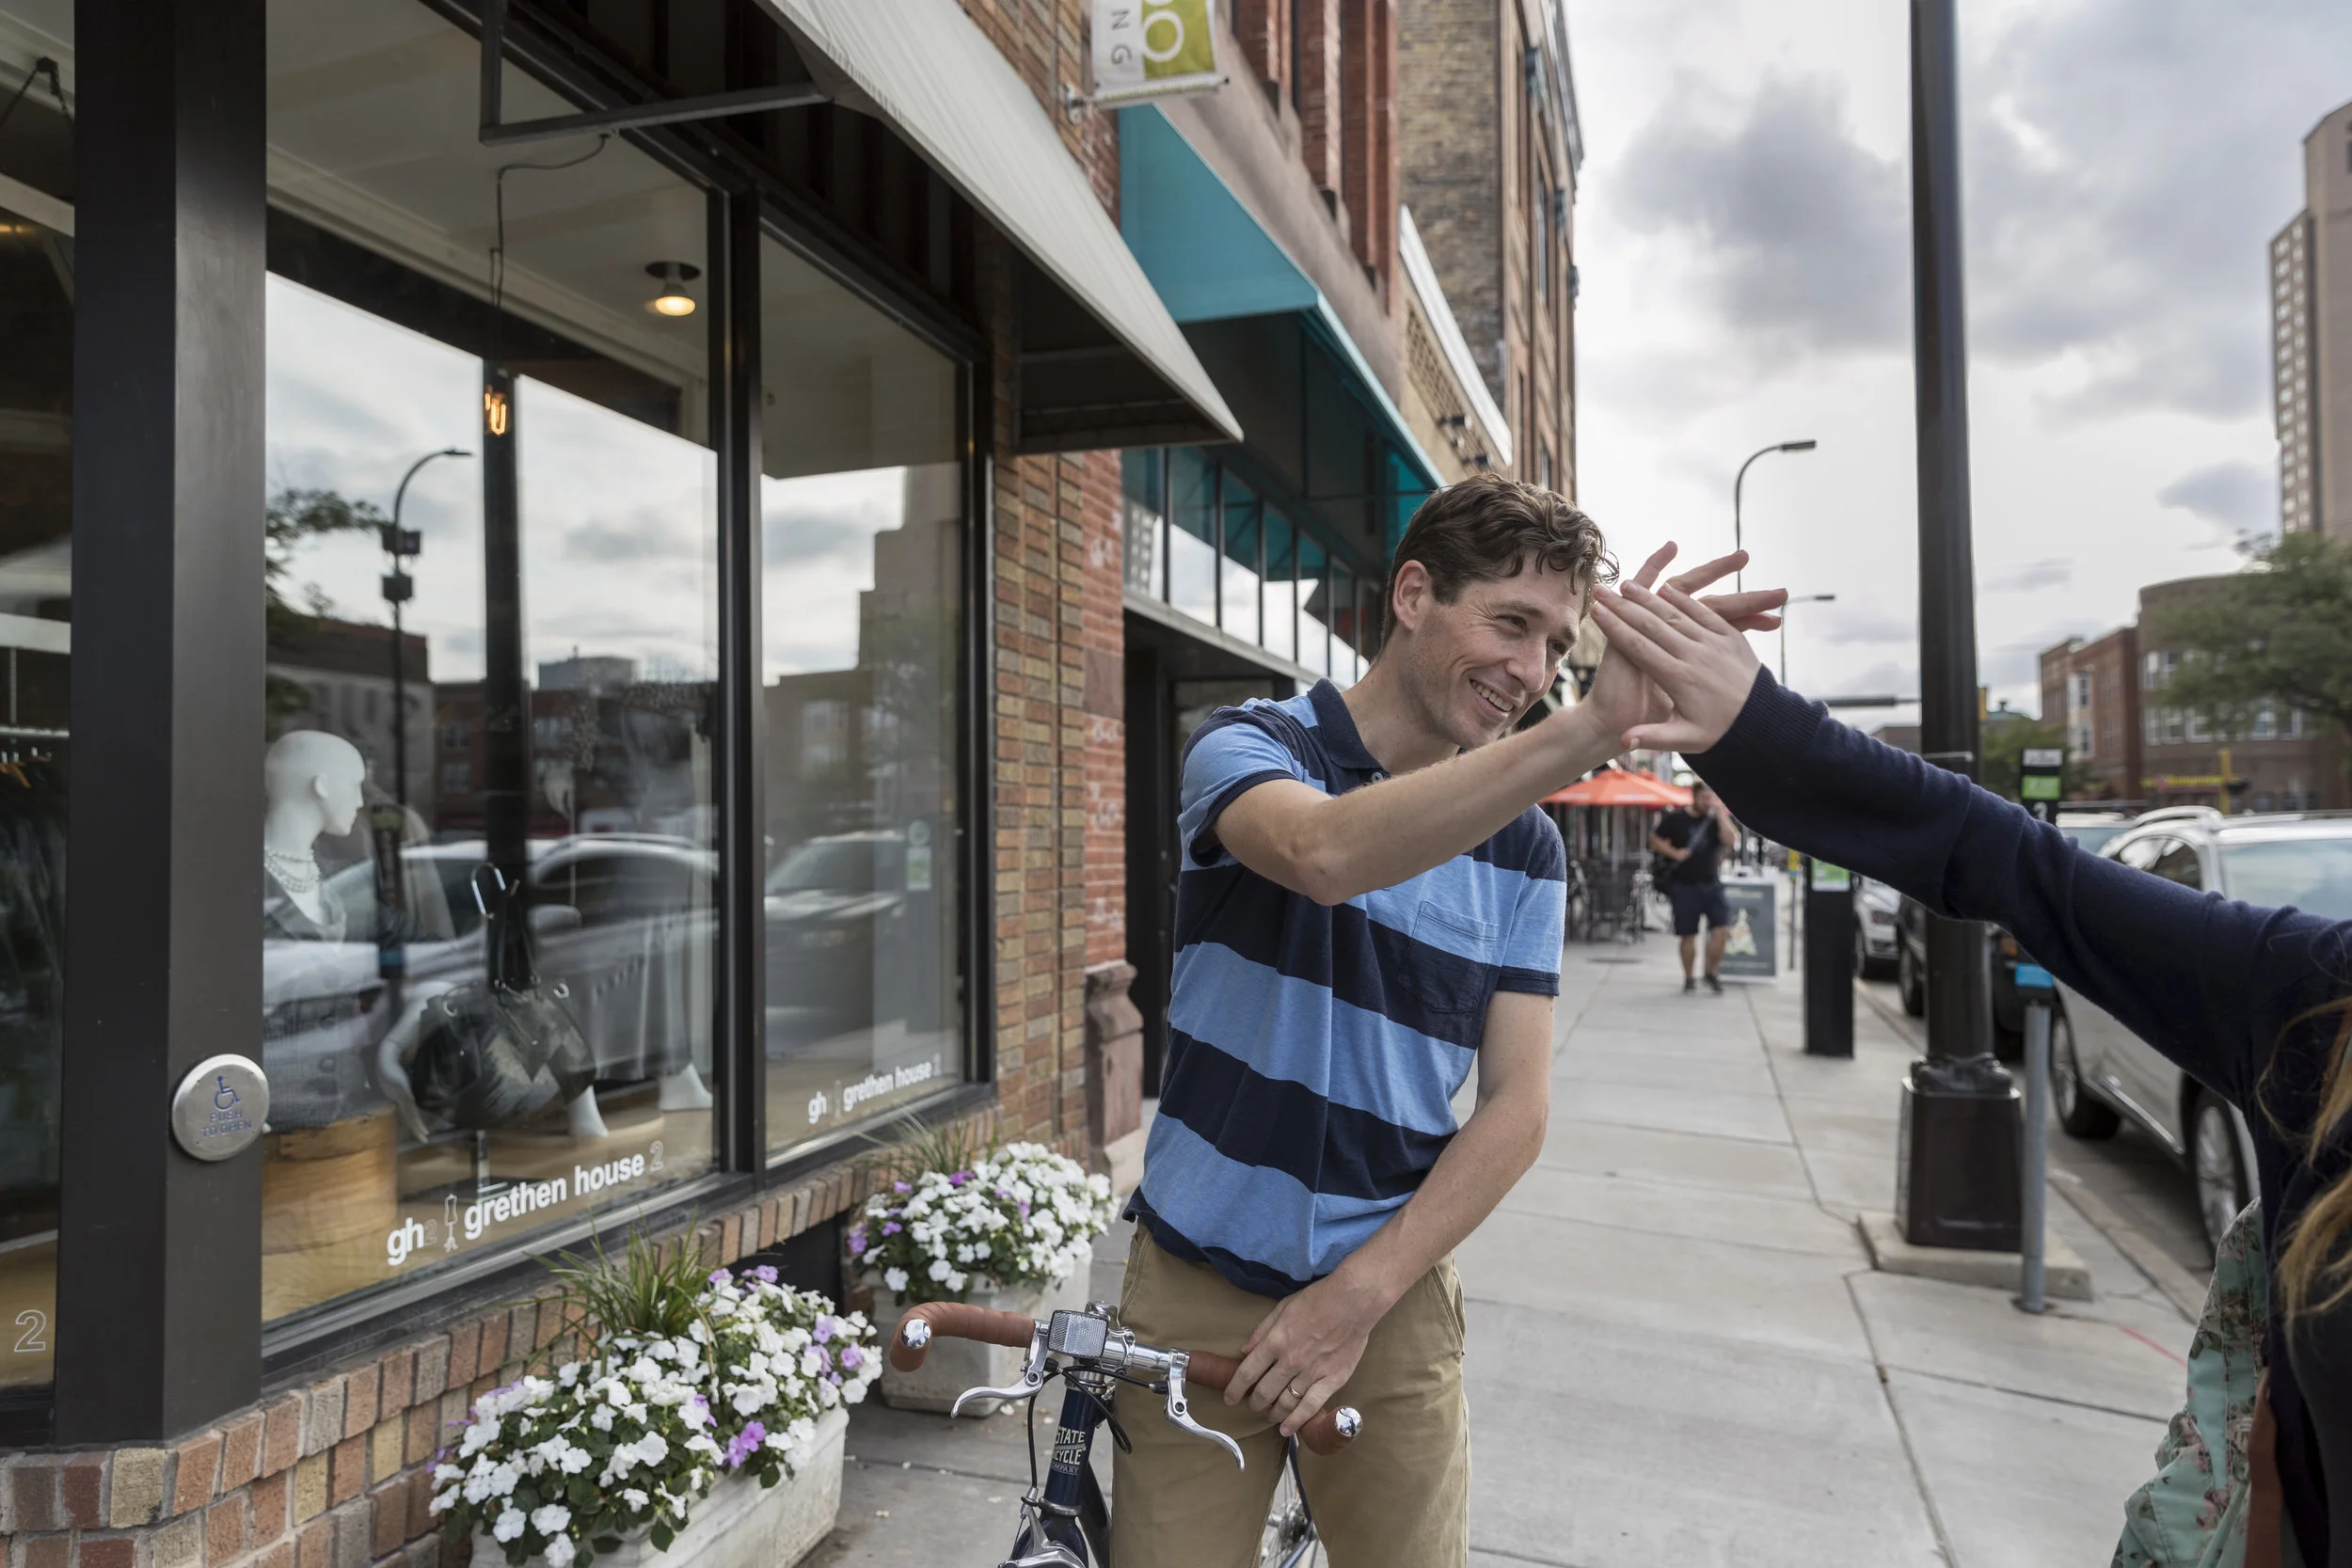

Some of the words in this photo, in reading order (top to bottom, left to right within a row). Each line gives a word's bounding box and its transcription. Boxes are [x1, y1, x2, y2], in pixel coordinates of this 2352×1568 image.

[843, 1073, 894, 1112] grethen
[895, 1061, 932, 1087] house
[201, 1126, 217, 1137] TO
[220, 1120, 252, 1136] OPEN
[209, 1110, 243, 1123] PUSH
[464, 1178, 567, 1241] grethen
[574, 1153, 645, 1196] house
[648, 1140, 664, 1173] 2
[14, 1308, 47, 1353] 2
